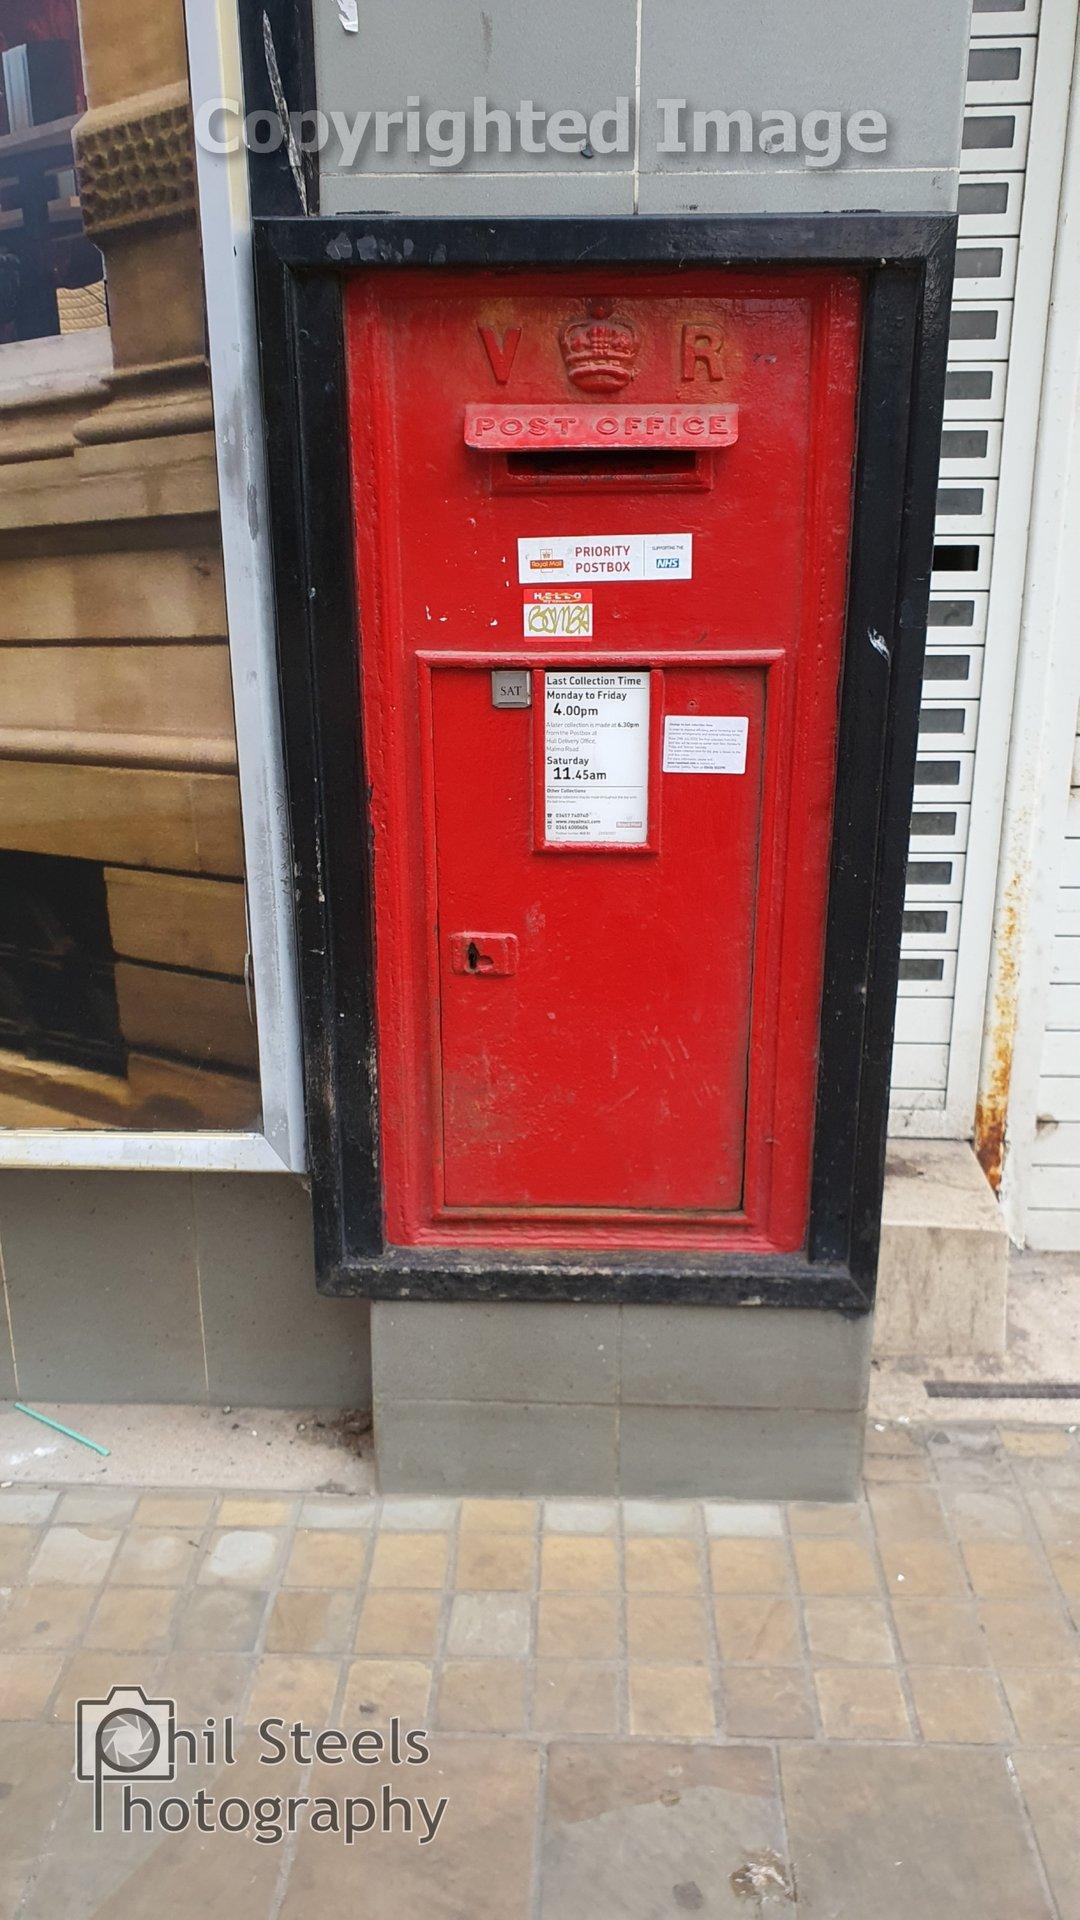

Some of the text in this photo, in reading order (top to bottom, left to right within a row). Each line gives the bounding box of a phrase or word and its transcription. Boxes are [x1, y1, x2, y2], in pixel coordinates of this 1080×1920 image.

[477, 322, 725, 385] V R
[475, 416, 729, 436] POST OFFICE
[575, 545, 631, 557] PRIORITY
[531, 560, 547, 568] Royal
[575, 561, 631, 573] POSTBOX
[657, 558, 678, 568] NHS
[533, 592, 582, 600] HELLO
[547, 676, 641, 685] Last Collection Time
[500, 685, 522, 696] SAT
[547, 691, 627, 701] Monday to Friday
[553, 702, 598, 718] 4.00pm
[547, 756, 589, 766] Saturday
[553, 767, 607, 780] 11.45am
